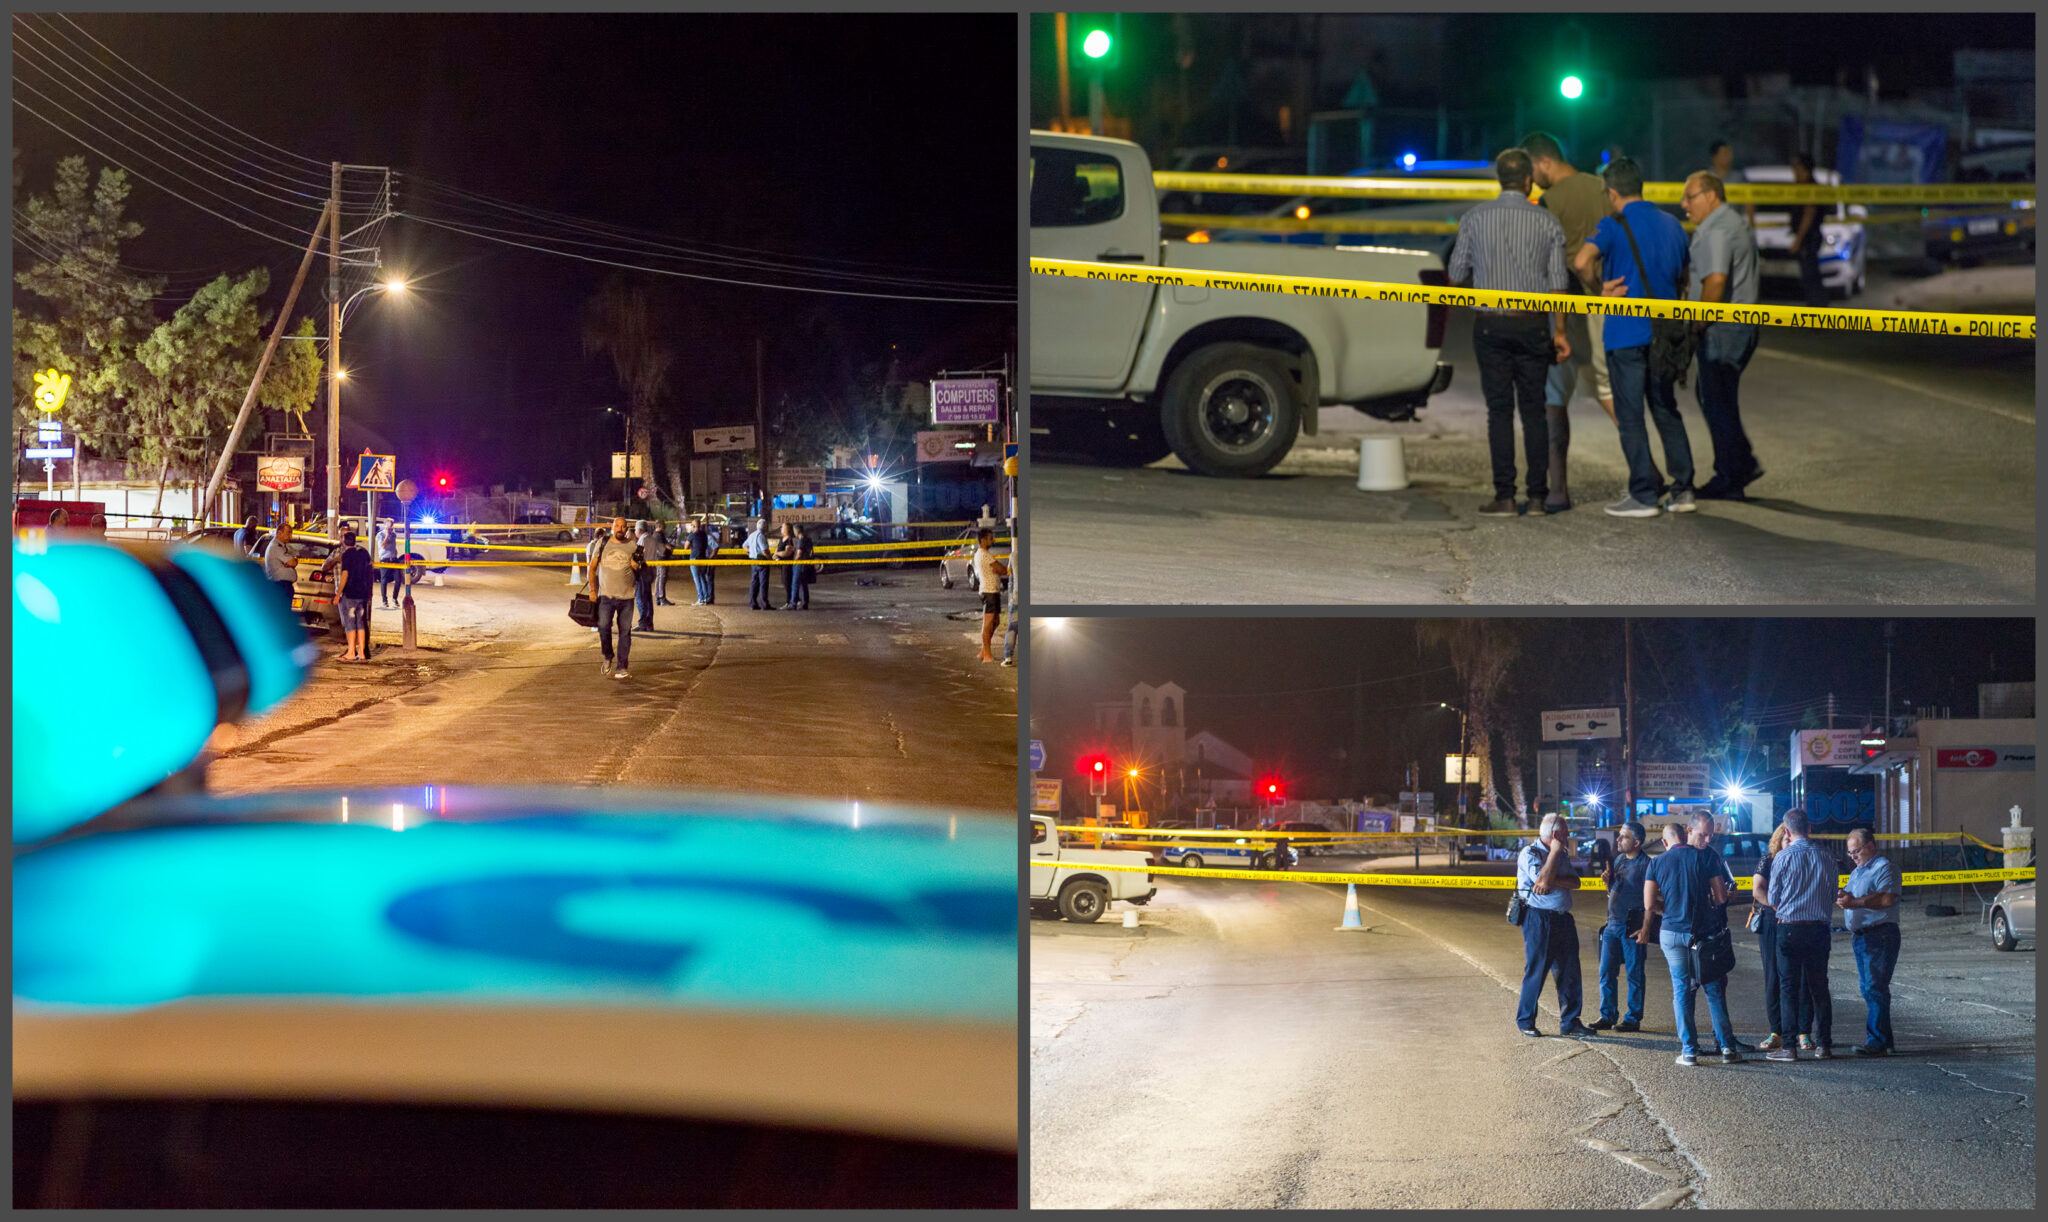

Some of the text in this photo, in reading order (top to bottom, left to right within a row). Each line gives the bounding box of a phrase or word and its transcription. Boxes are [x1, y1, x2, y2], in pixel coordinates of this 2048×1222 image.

[1672, 306, 1724, 322] POLICE
[1733, 310, 1770, 326] STOP
[1790, 313, 1873, 332] ΑΣΤΥΝΟΜΙΑ
[1881, 316, 1949, 335] ΣΤΑΜΑΤΑ
[1969, 320, 2021, 339] POLICE
[2029, 323, 2036, 339] S
[937, 388, 996, 404] COMPUTERS
[941, 405, 962, 413] SALES
[968, 404, 992, 412] REPAIR
[1984, 871, 2001, 879] POLICE
